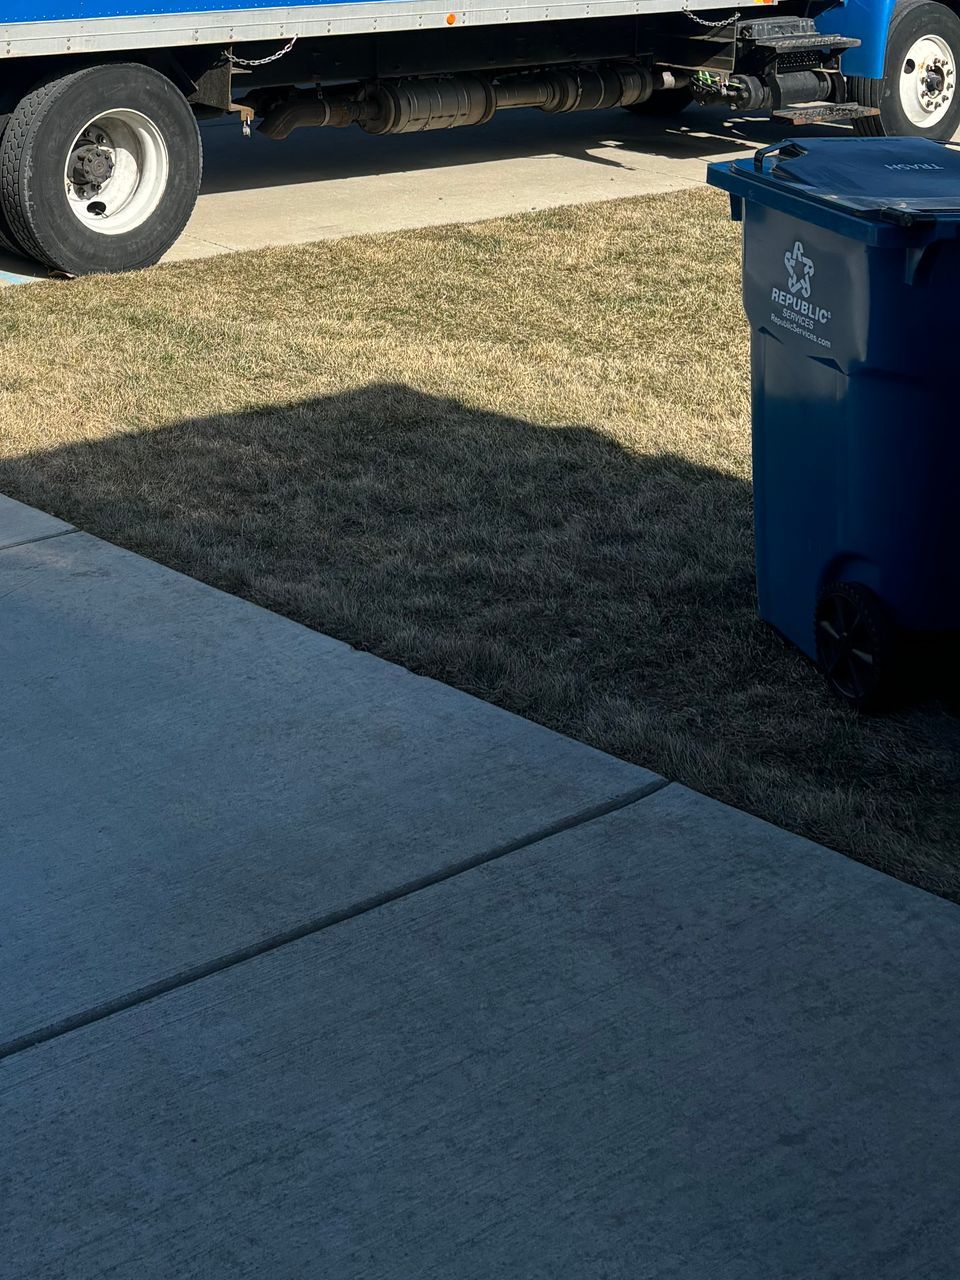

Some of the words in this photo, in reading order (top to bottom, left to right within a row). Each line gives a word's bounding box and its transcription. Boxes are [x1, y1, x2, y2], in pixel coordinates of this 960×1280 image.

[771, 287, 828, 324] REPUBLIC
[782, 308, 814, 330] SERVICES
[770, 313, 831, 348] RepublicServices.com
